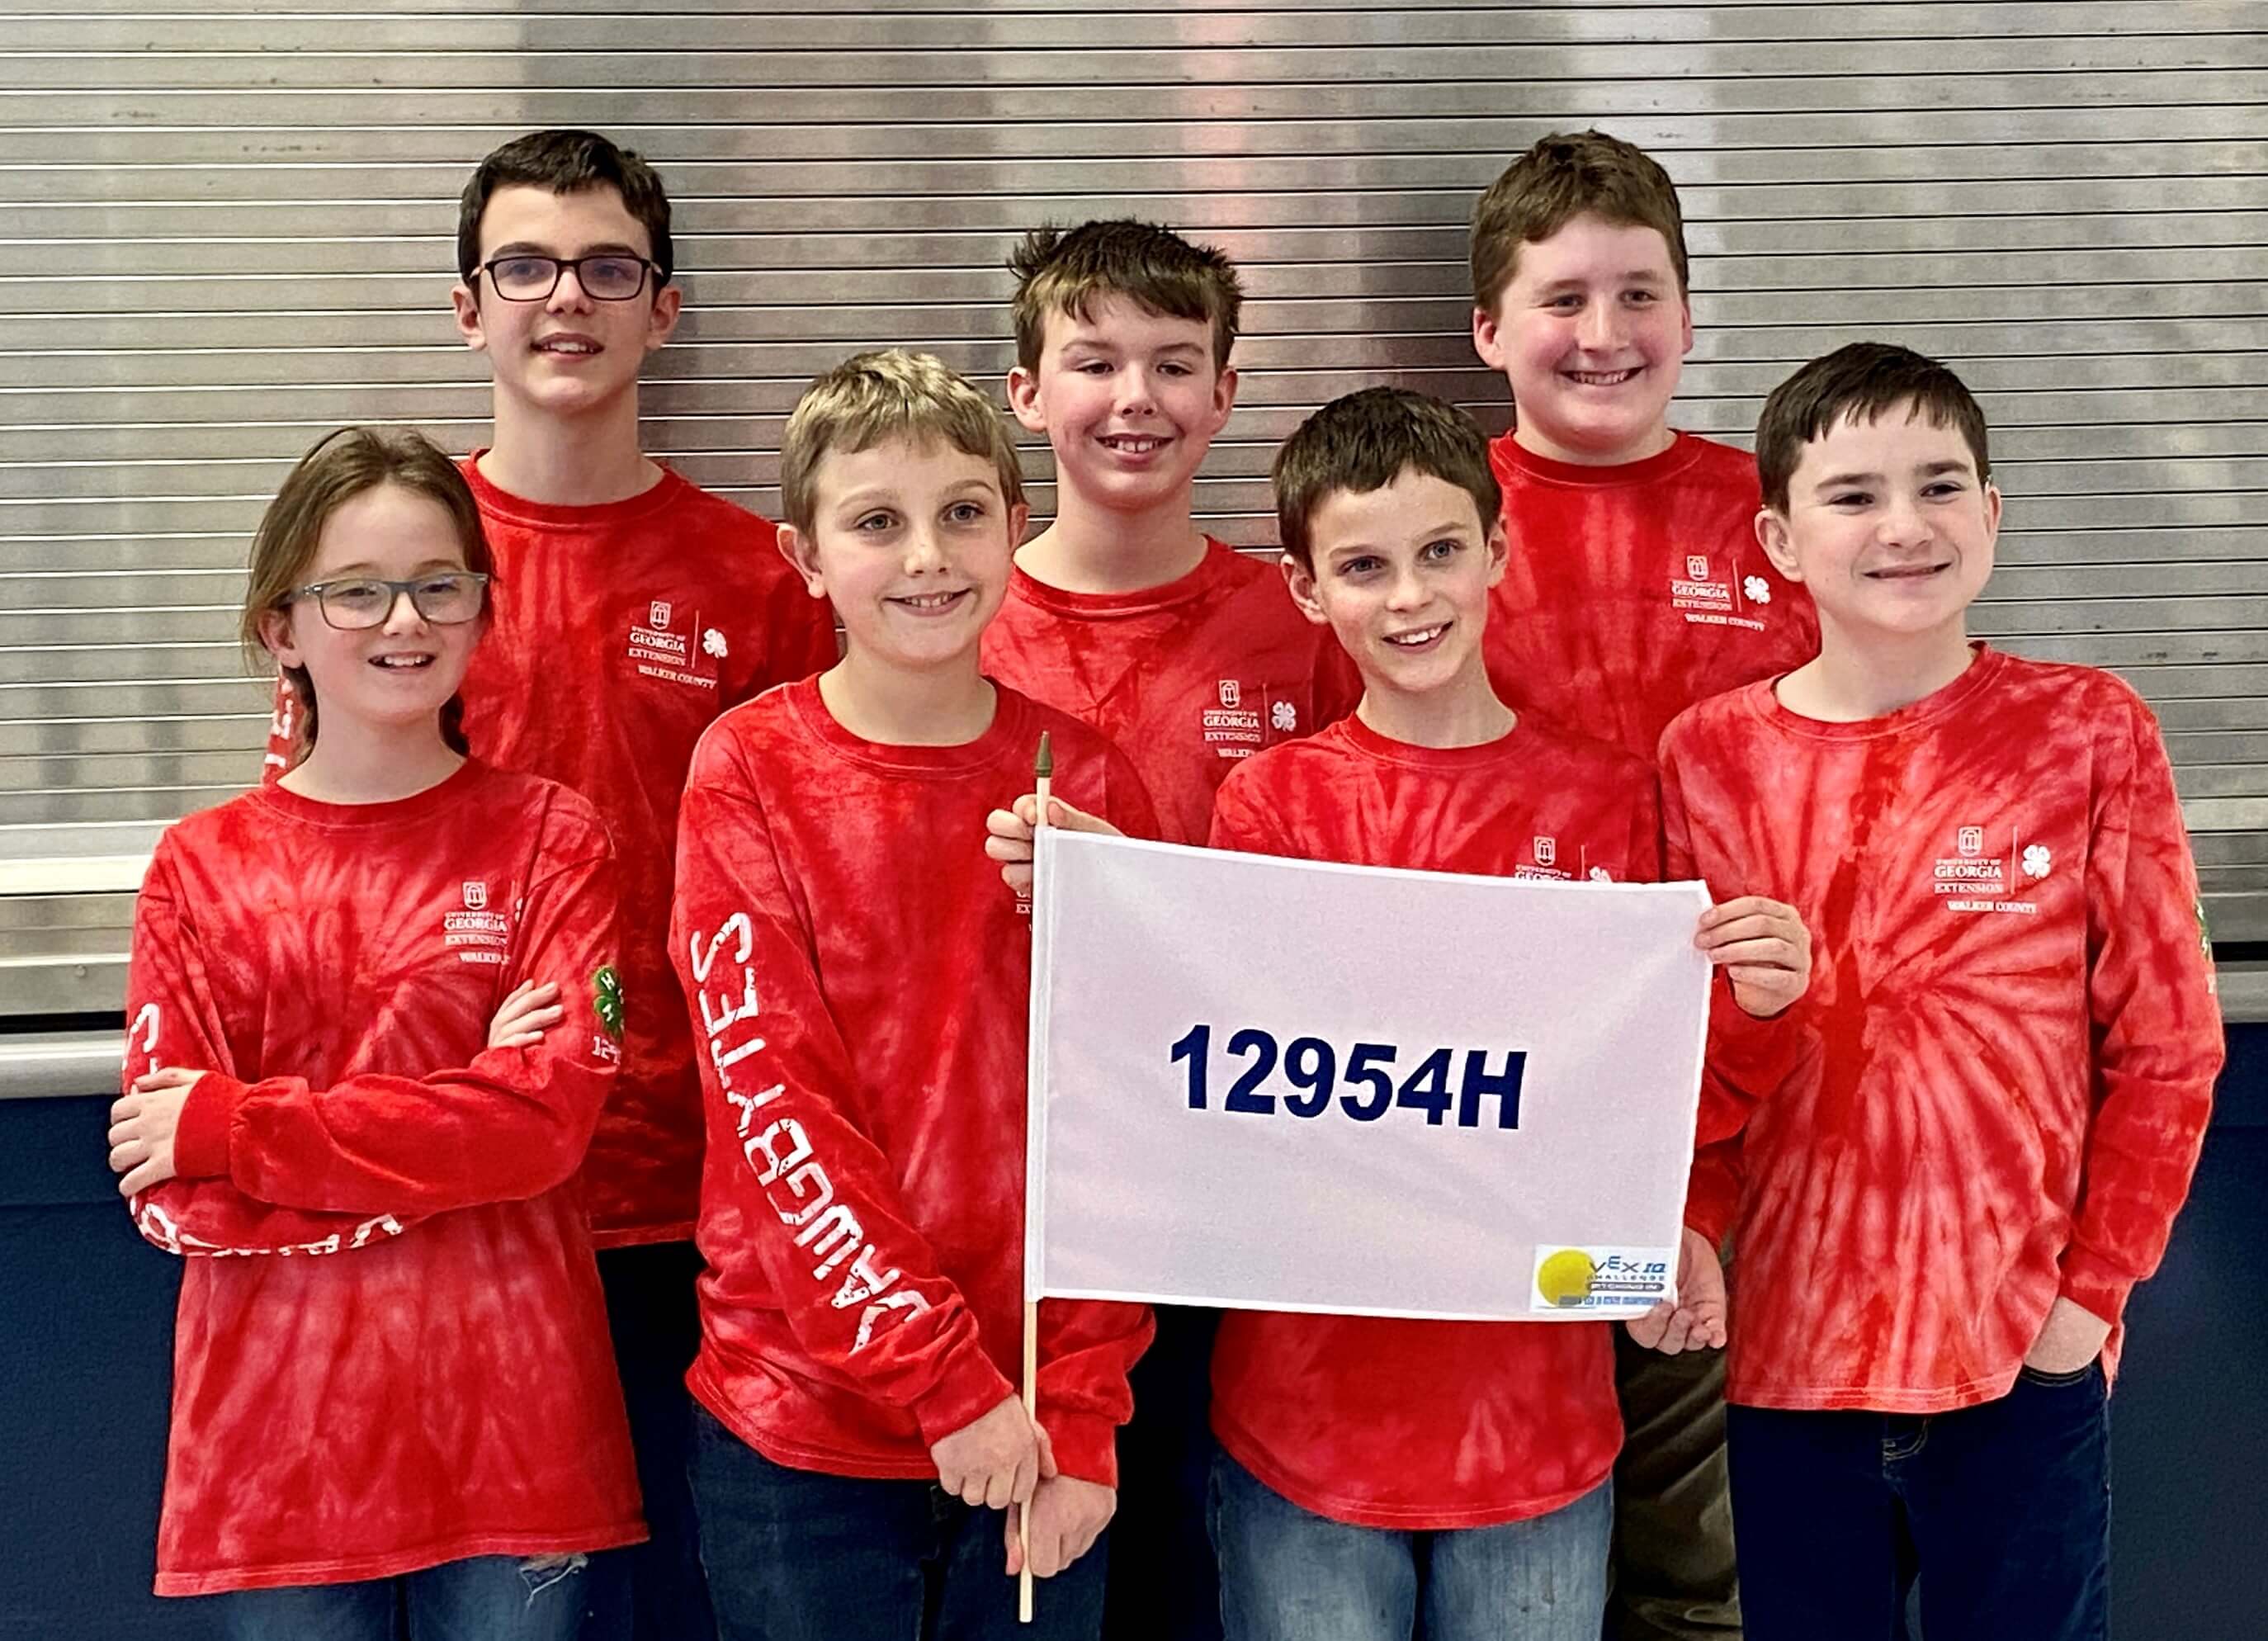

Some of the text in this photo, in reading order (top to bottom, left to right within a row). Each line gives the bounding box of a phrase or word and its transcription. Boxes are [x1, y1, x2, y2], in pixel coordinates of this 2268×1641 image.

[1671, 585, 1731, 600] GEORGIA
[1672, 598, 1732, 611] EXTENSION
[630, 631, 686, 653] GEORGIA
[628, 647, 687, 666] EXTENSION
[1203, 716, 1259, 728] GEORGIA
[1204, 731, 1261, 743] EXTENSION
[1934, 866, 2002, 878] GEORGIA
[1934, 882, 2004, 894] EXTENSION
[444, 918, 508, 932] GEORGIA
[445, 934, 508, 948] EXTENSION
[1170, 1024, 1528, 1130] 12954H
[1590, 1256, 1640, 1274] VEX
